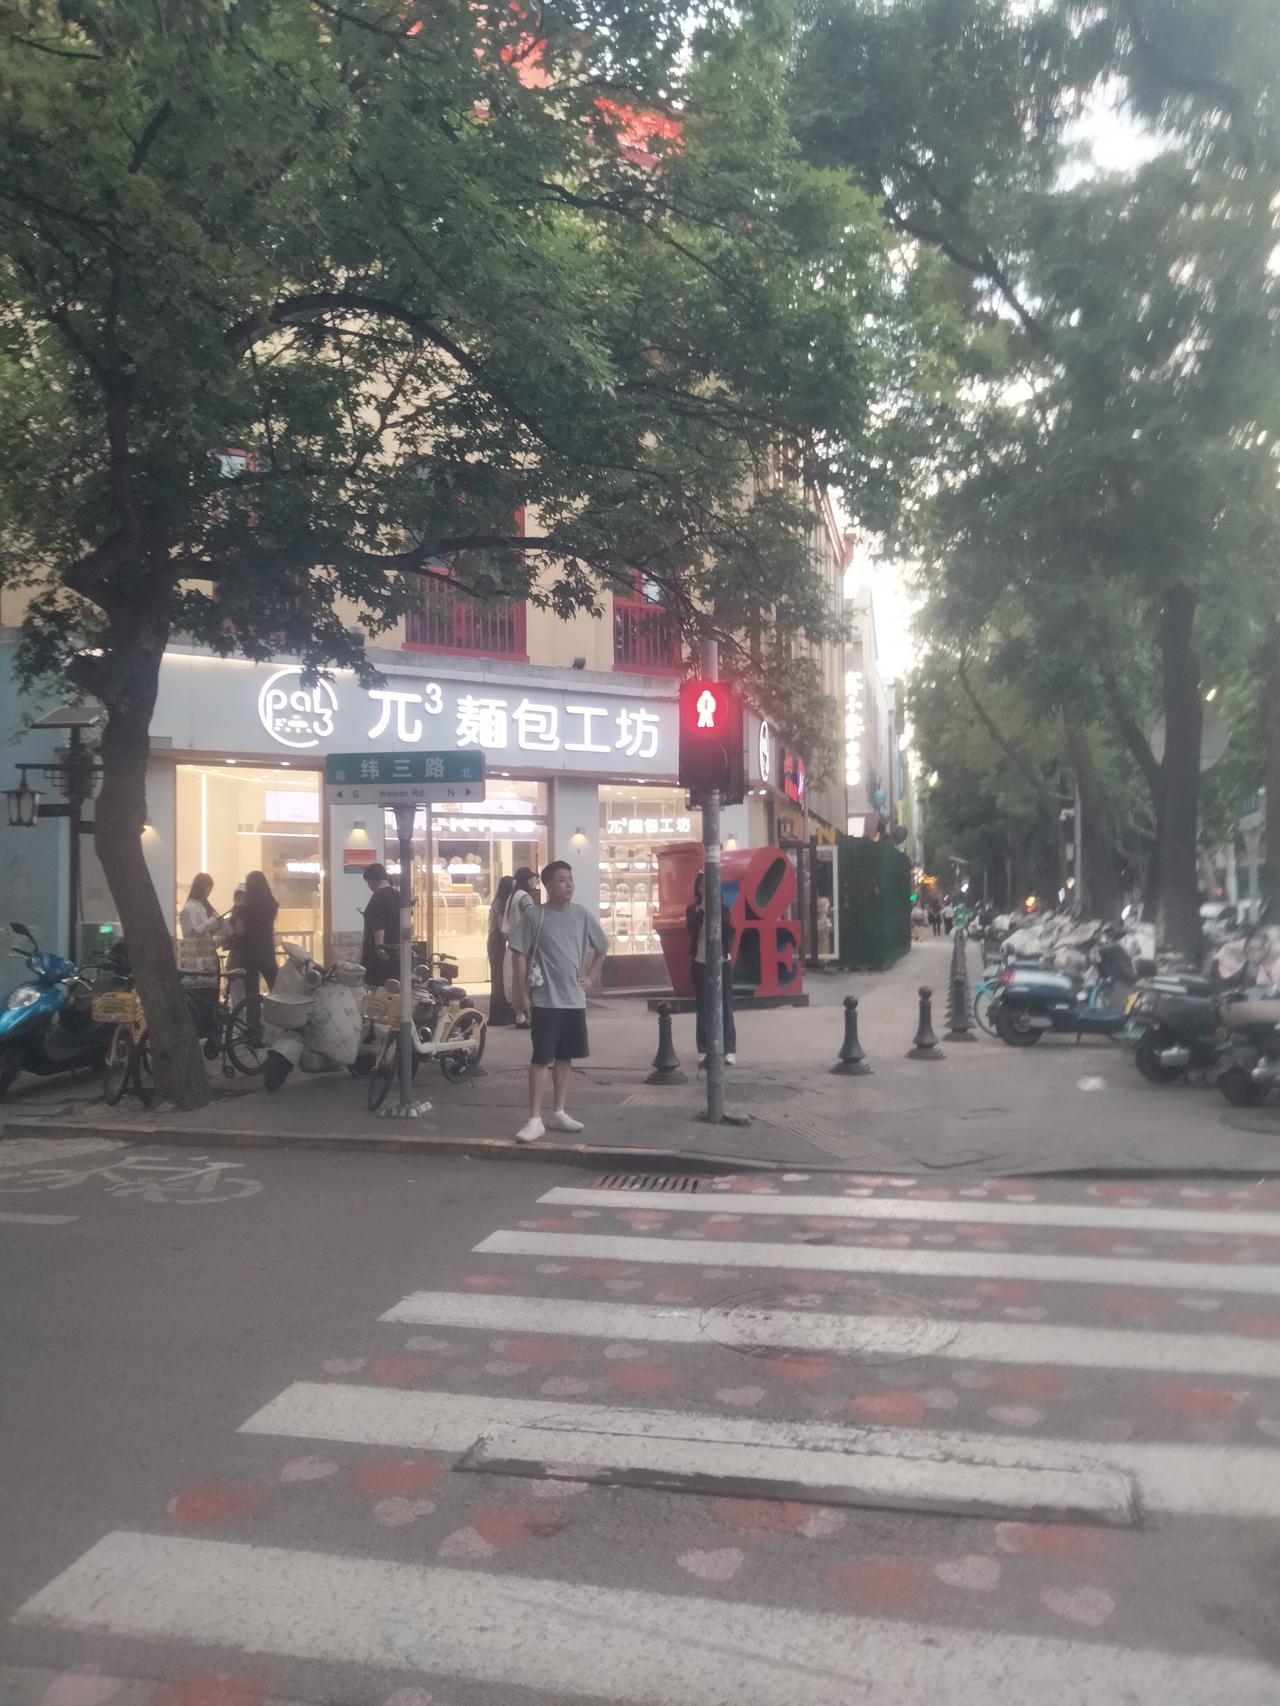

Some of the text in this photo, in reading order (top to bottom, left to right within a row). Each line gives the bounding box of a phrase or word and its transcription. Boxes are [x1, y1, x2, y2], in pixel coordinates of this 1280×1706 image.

[360, 756, 445, 780] 纬三路
[352, 789, 360, 800] S
[378, 788, 409, 798] Weisan
[447, 787, 455, 797] N
